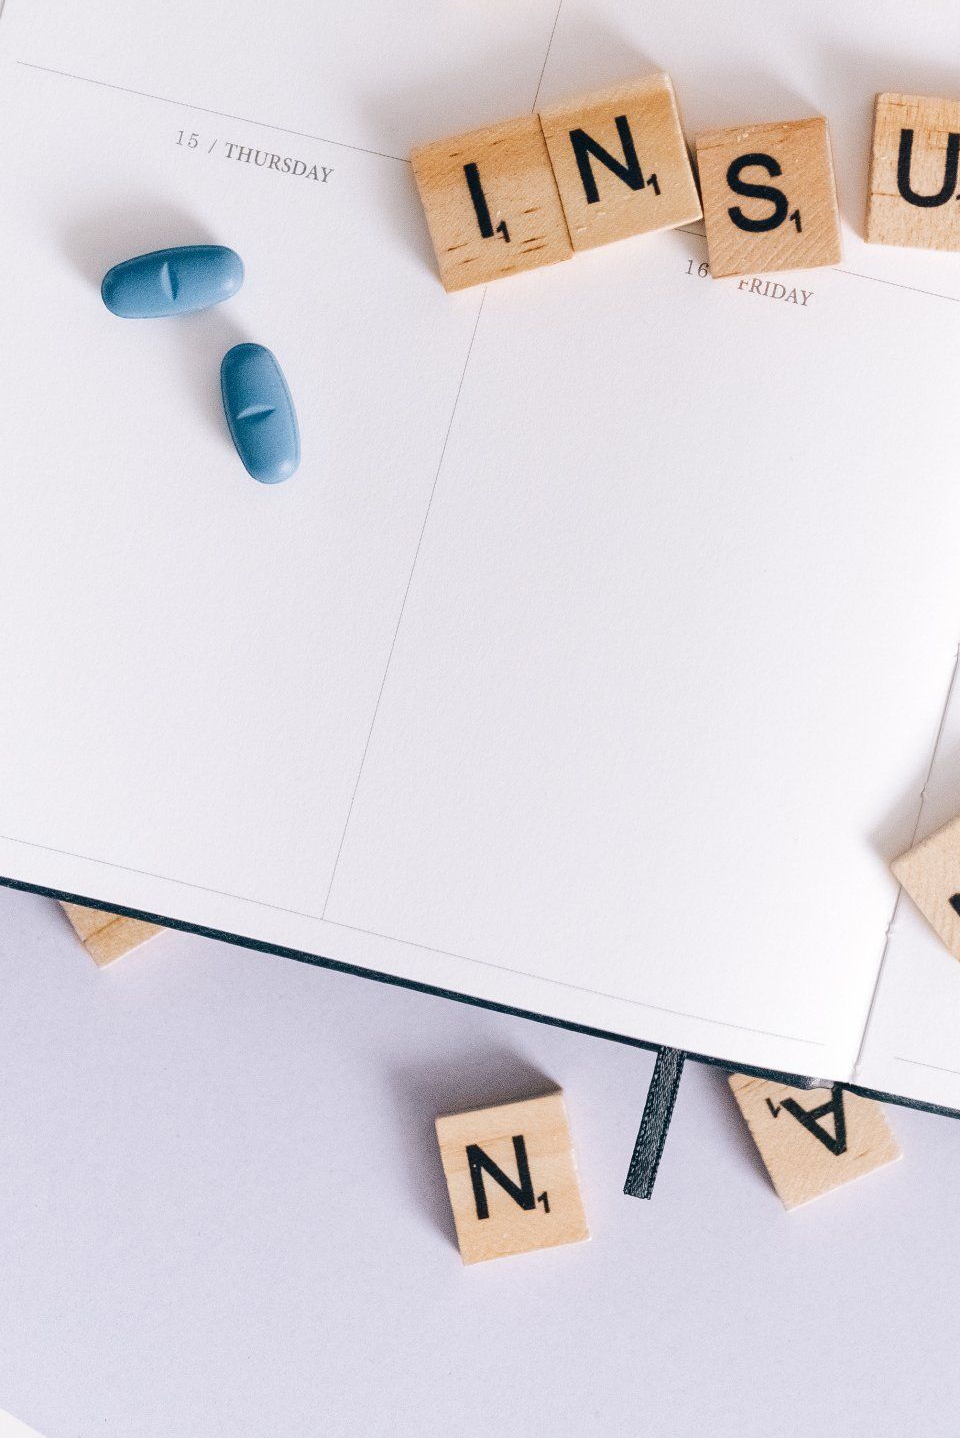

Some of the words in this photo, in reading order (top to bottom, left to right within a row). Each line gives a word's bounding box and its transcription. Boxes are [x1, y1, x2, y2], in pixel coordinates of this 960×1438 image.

[176, 130, 199, 149] 15
[226, 143, 334, 183] THURSDAY
[686, 260, 709, 279] 16
[779, 1084, 848, 1157] A
